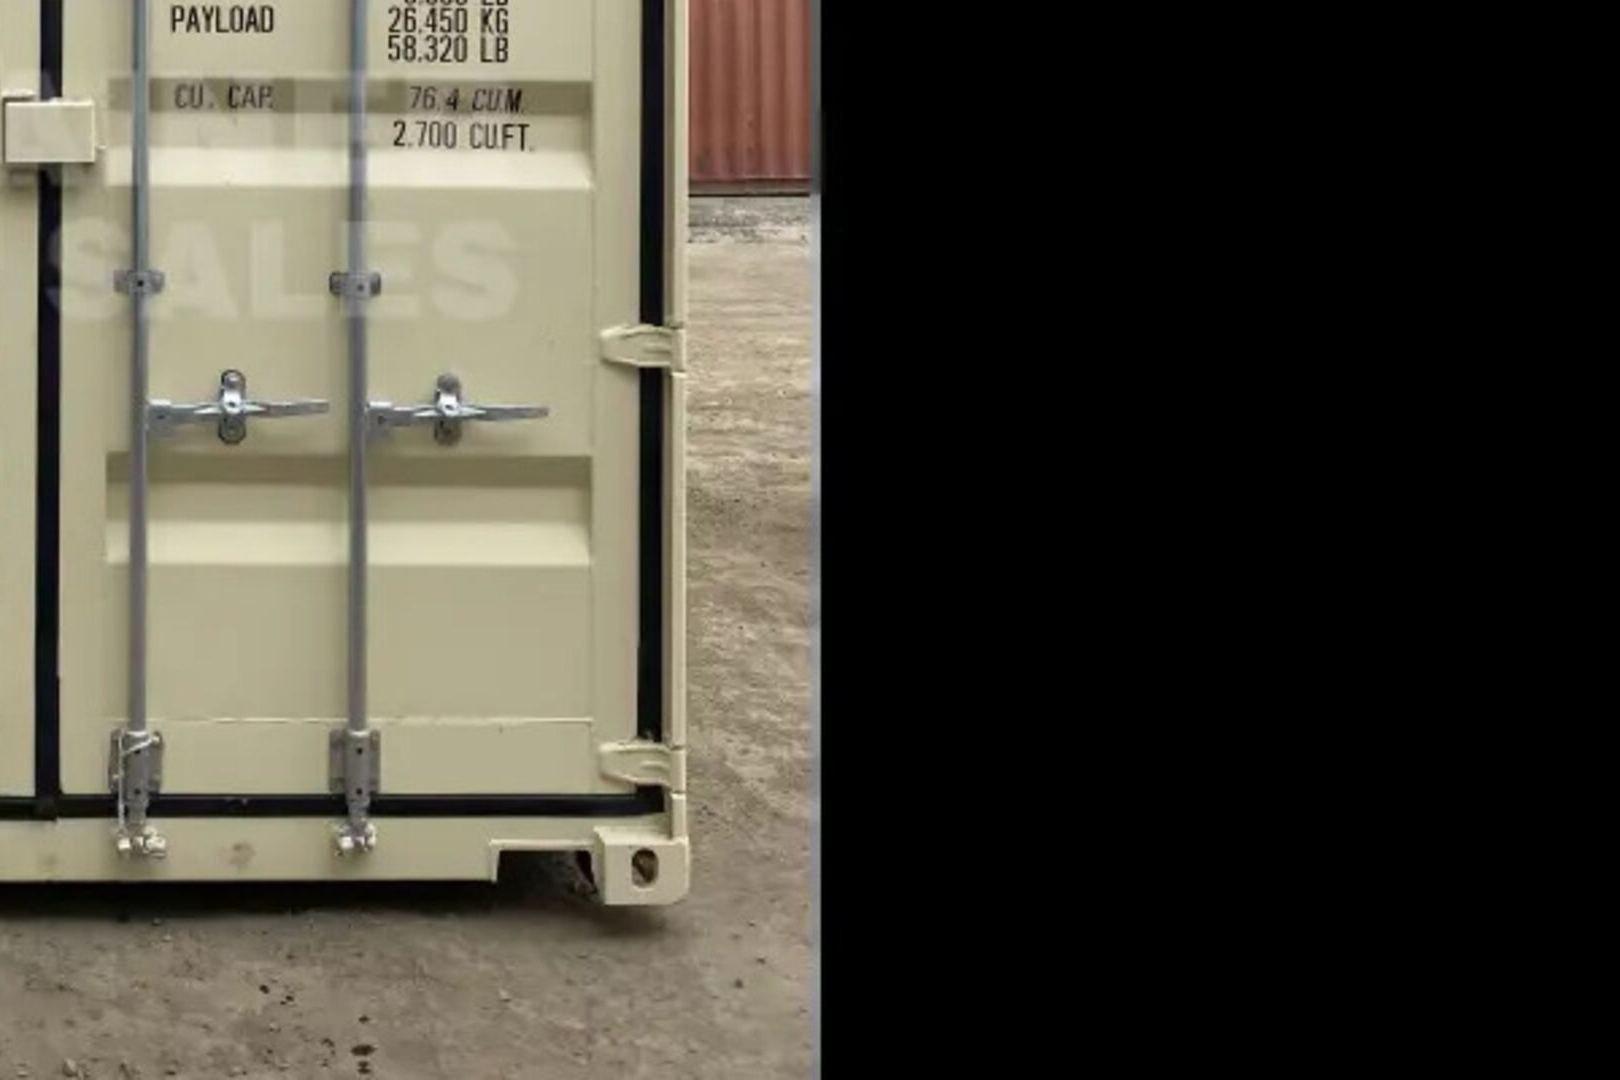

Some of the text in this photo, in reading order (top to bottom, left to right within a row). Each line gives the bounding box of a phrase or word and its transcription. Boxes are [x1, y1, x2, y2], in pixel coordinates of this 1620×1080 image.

[171, 5, 509, 35] PAYLOAD 26.450 KG
[387, 34, 509, 63] 58.320 LB
[175, 84, 215, 109] CU.
[227, 84, 274, 109] CAP.
[411, 86, 460, 111] 76.4
[393, 120, 458, 149] 2.700
